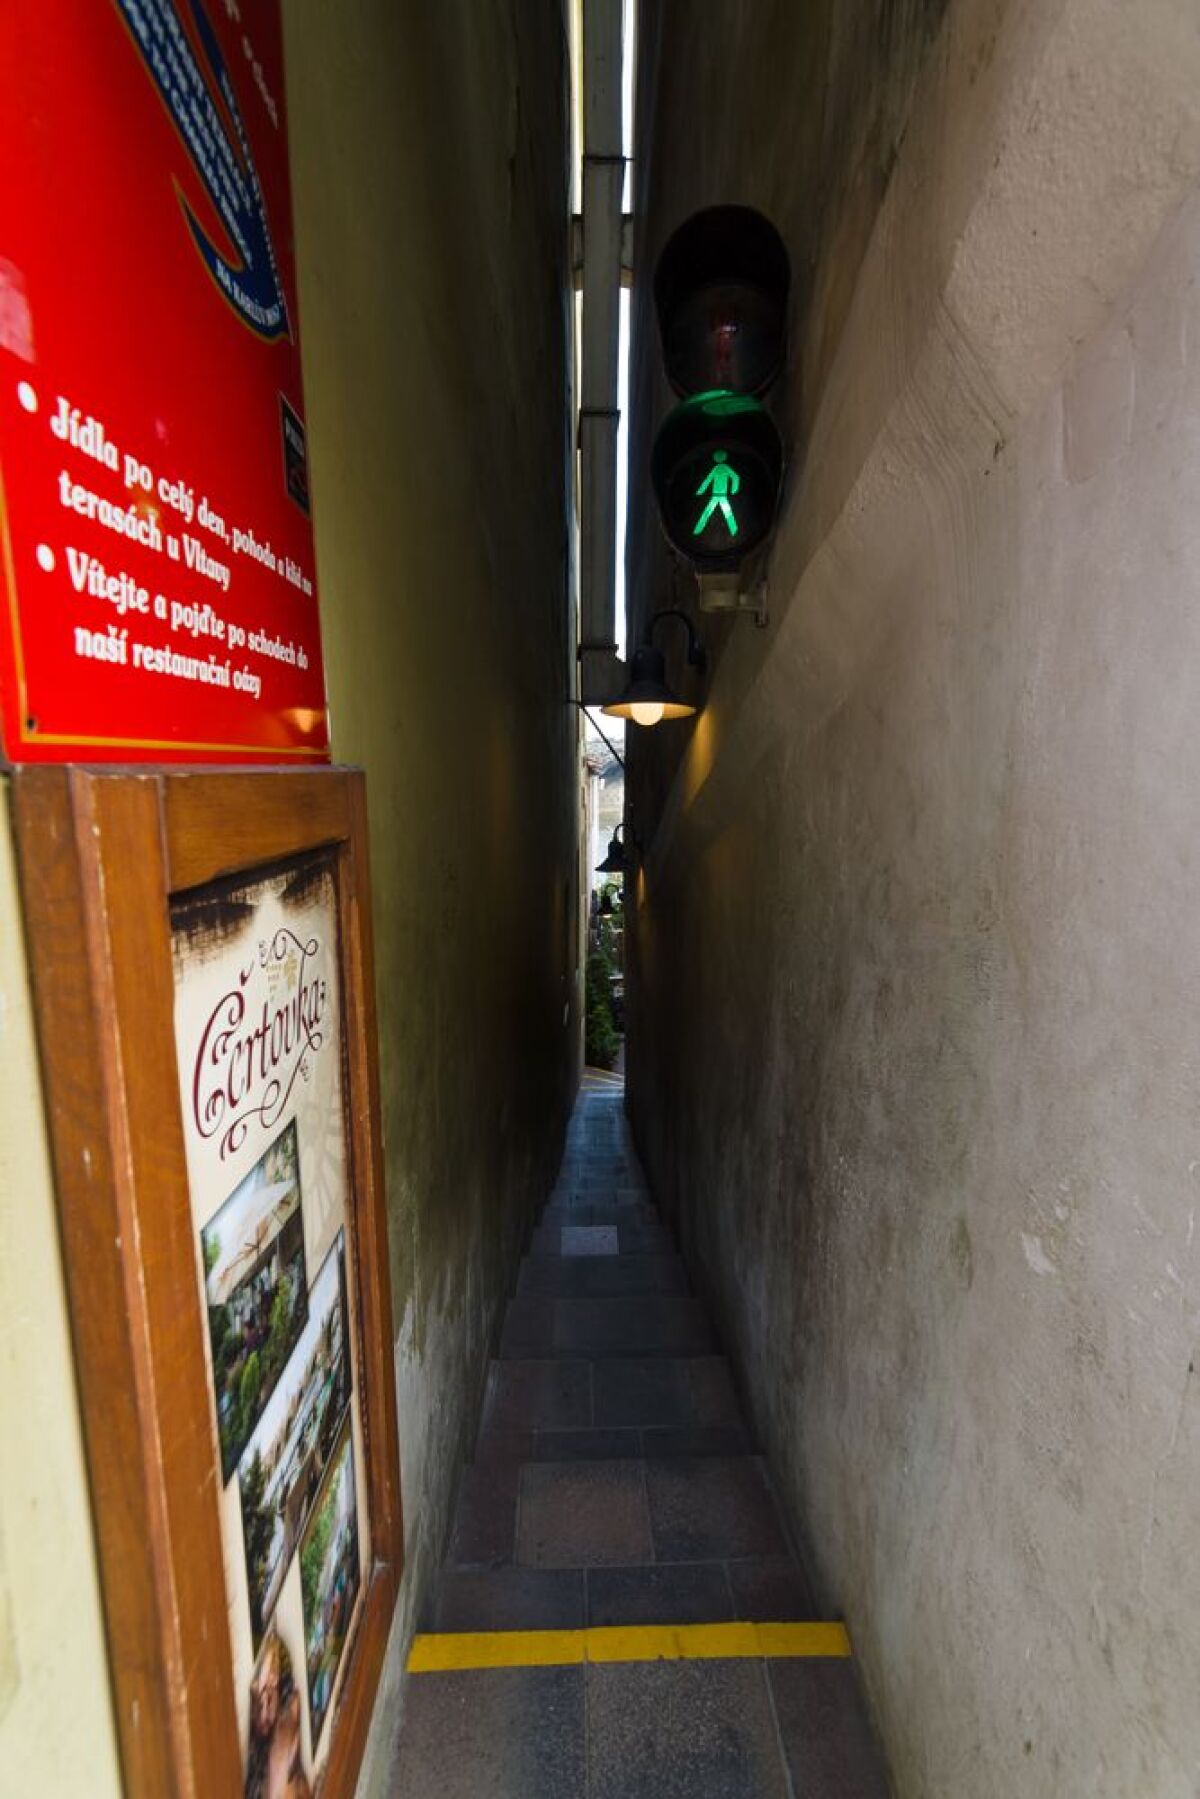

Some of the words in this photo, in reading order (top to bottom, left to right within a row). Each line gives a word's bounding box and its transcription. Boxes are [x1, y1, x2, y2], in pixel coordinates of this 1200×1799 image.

[50, 395, 119, 471] Jídla
[124, 454, 153, 490] po
[158, 477, 193, 523] celý
[198, 497, 230, 544] den,
[58, 469, 162, 551] terasách
[166, 534, 180, 561] u
[182, 533, 230, 591] Vltavy
[65, 547, 149, 615] Vítejte
[154, 594, 167, 619] a
[171, 600, 225, 638] pojďte
[228, 622, 245, 650] po
[74, 624, 127, 664] naší
[133, 641, 230, 688] restaurační
